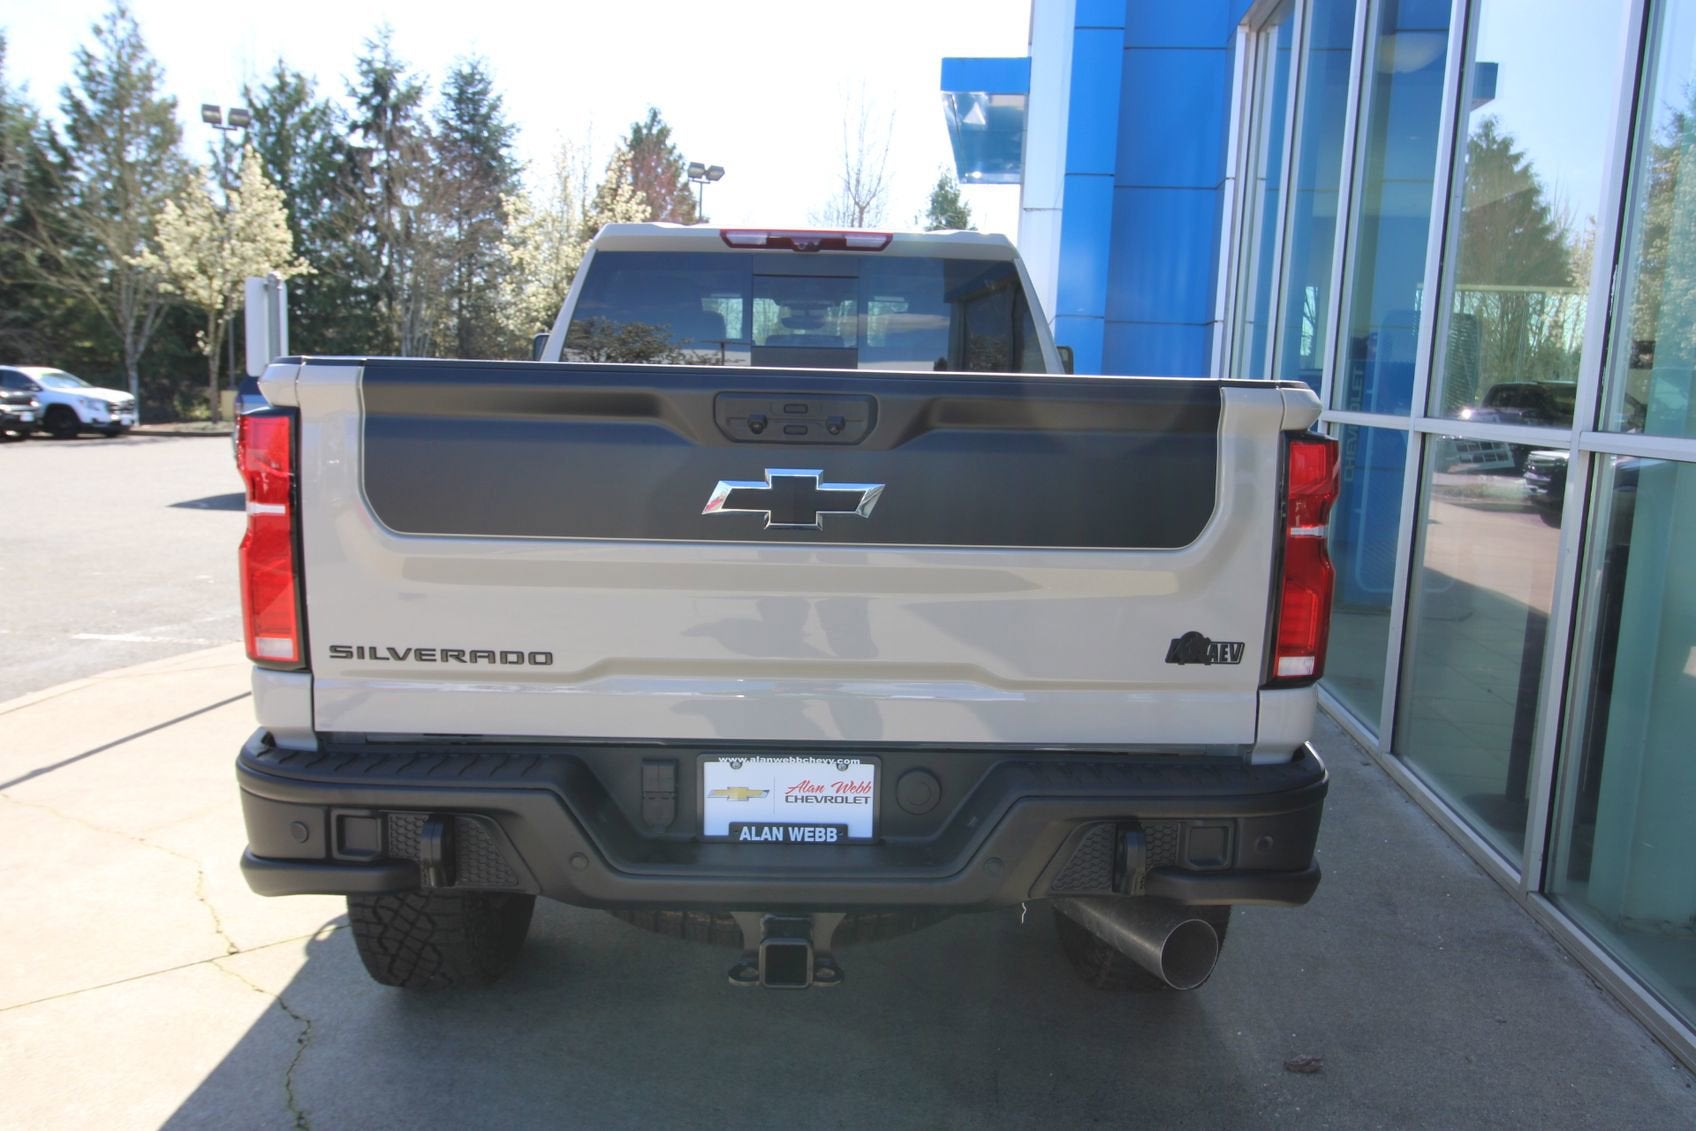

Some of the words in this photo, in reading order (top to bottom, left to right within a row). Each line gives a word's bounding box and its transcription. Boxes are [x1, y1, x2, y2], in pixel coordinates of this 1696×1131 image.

[1343, 367, 1364, 482] CHEVOLET
[329, 644, 554, 666] SILVERADO
[1207, 643, 1243, 663] AEV
[718, 756, 861, 766] www.alanwebbchevy.com
[785, 779, 825, 794] Alan
[831, 780, 872, 794] Webb
[785, 795, 872, 805] CHEVROLET
[739, 826, 784, 841] ALAN
[789, 827, 837, 842] WEBB
